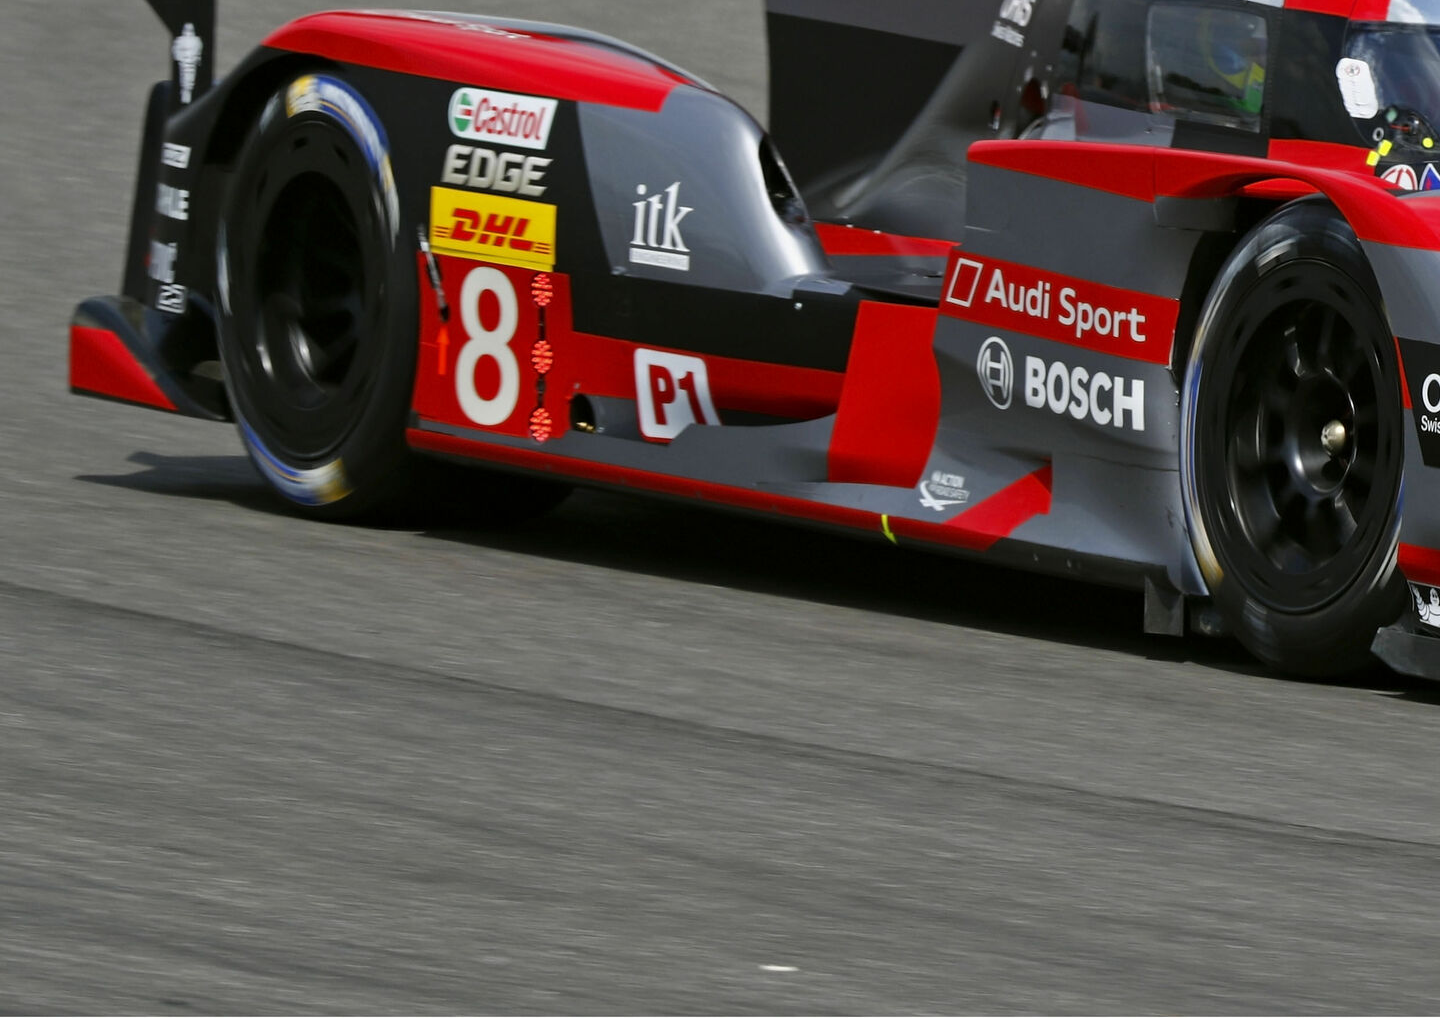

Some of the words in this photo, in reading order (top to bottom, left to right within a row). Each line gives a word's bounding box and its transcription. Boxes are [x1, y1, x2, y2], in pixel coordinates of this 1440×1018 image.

[474, 97, 546, 141] Castrol
[441, 144, 554, 197] EDGE
[450, 208, 534, 252] DHL
[629, 181, 695, 253] itk
[984, 268, 1051, 320] Audi
[1057, 286, 1146, 342] Sport
[455, 266, 520, 426] 8
[648, 364, 707, 426] P1
[1024, 355, 1145, 431] BOSCH
